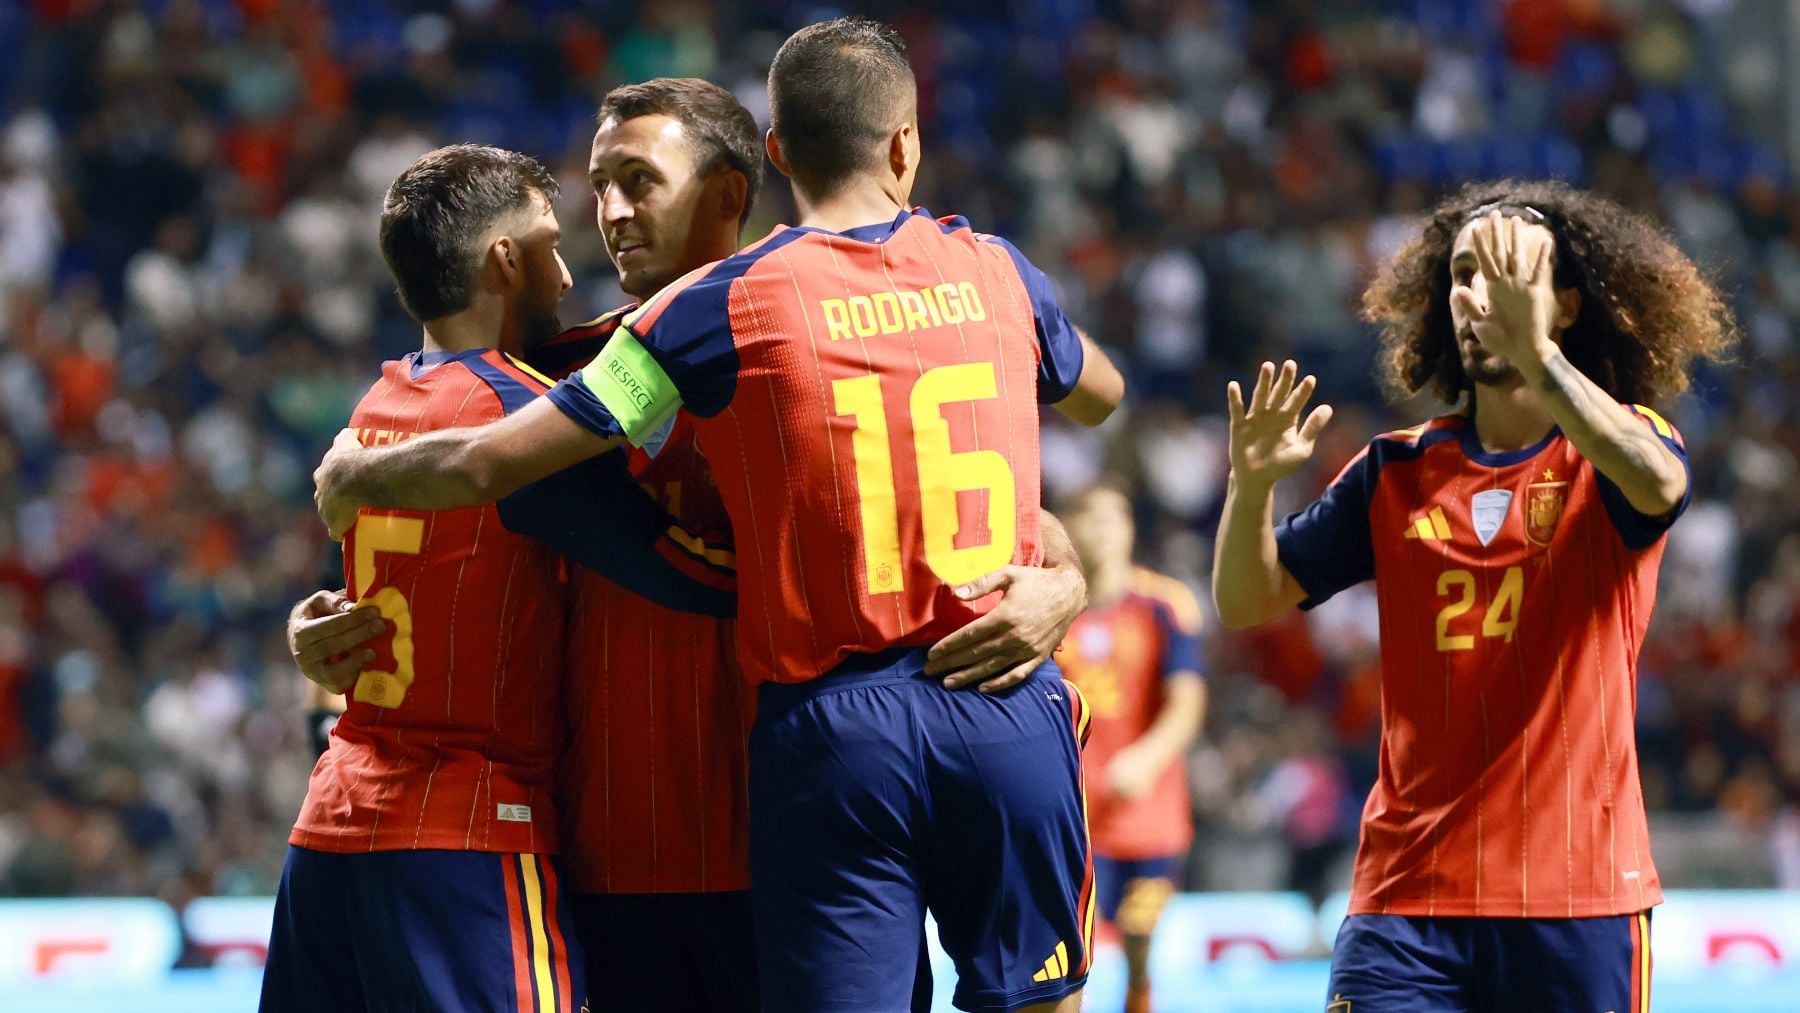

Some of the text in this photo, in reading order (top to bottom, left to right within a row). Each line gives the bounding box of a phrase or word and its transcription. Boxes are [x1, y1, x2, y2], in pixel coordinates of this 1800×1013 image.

[820, 281, 986, 341] RODRIGO
[608, 359, 653, 410] RESPECT
[832, 362, 1016, 595] 16
[354, 514, 424, 709] 5
[1436, 566, 1524, 652] 24
